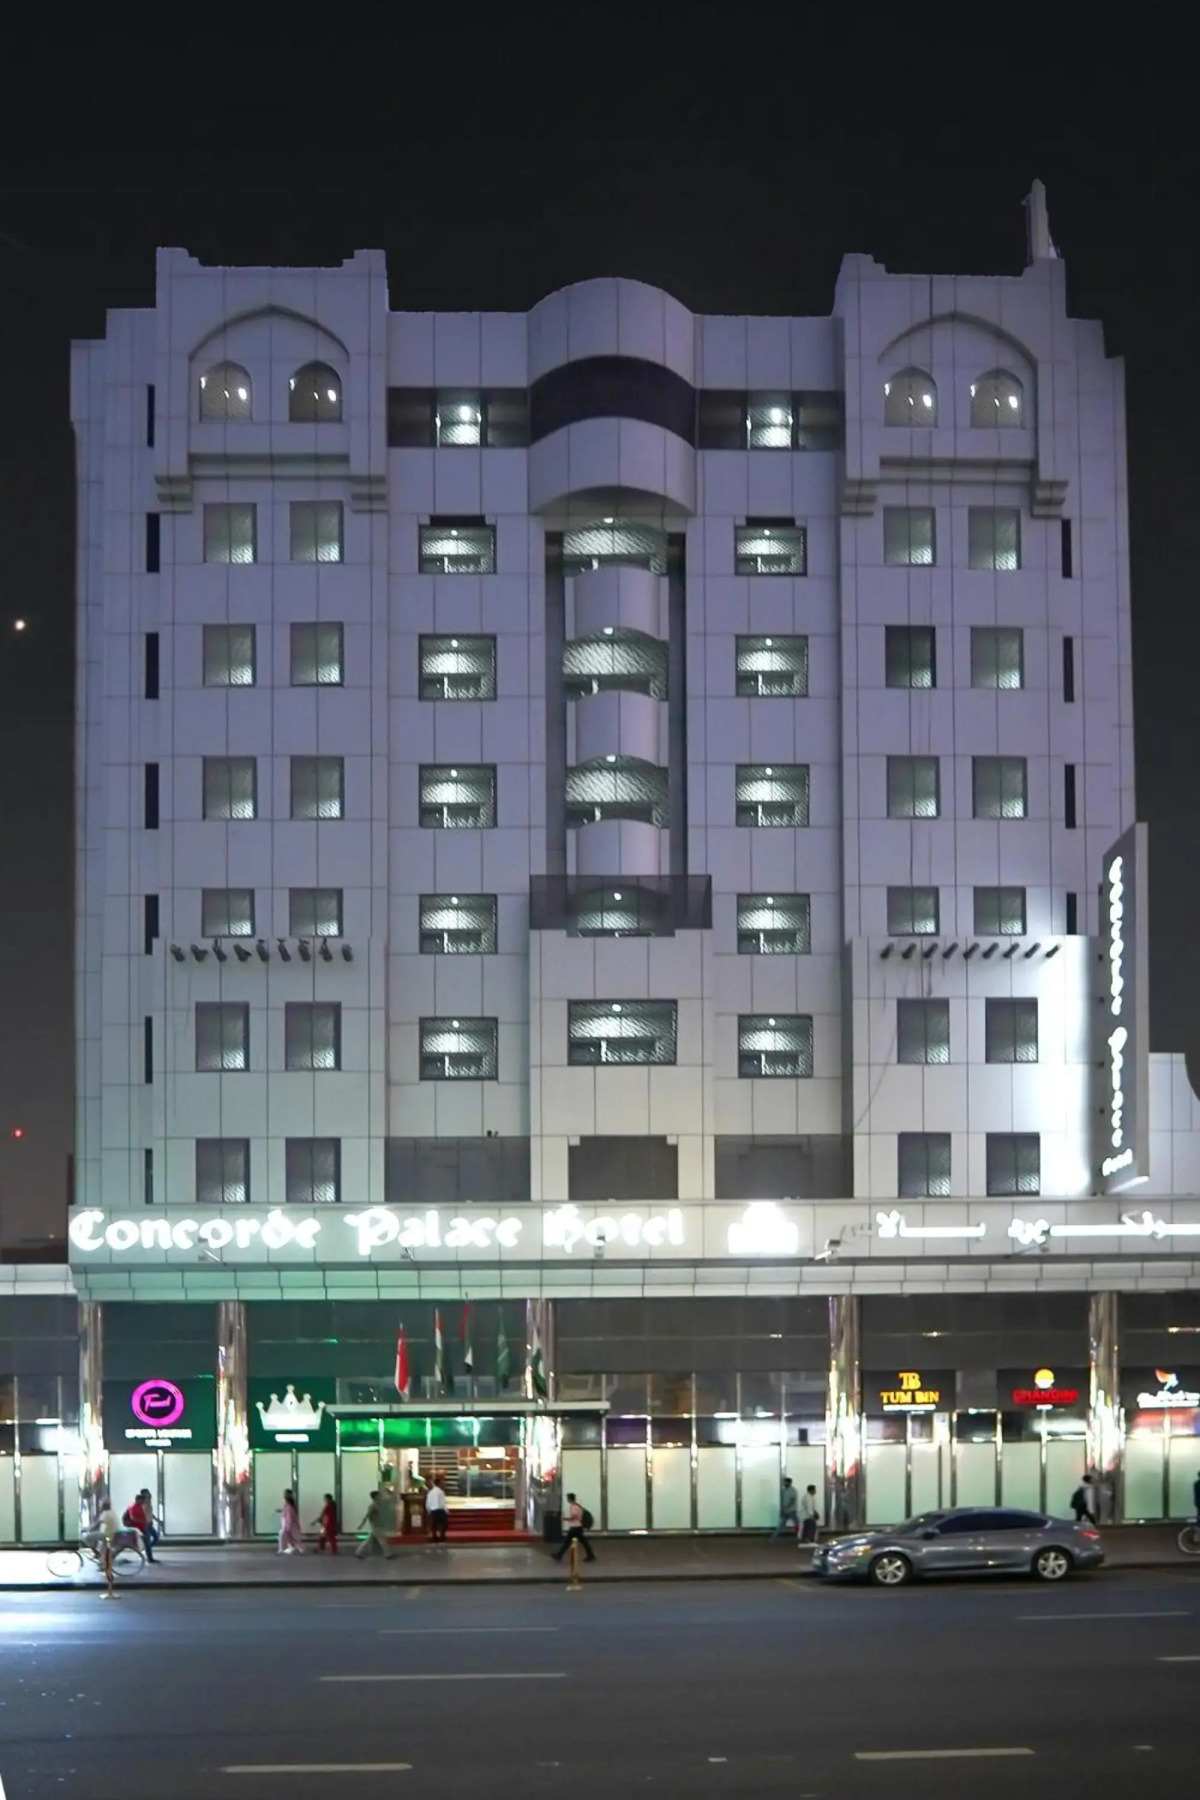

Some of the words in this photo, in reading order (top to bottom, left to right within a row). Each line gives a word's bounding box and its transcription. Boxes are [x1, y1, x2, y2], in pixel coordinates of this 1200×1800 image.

[69, 1209, 321, 1257] Concorde
[345, 1208, 522, 1256] Palace
[542, 1208, 685, 1255] Hotel
[880, 1391, 912, 1404] TUM
